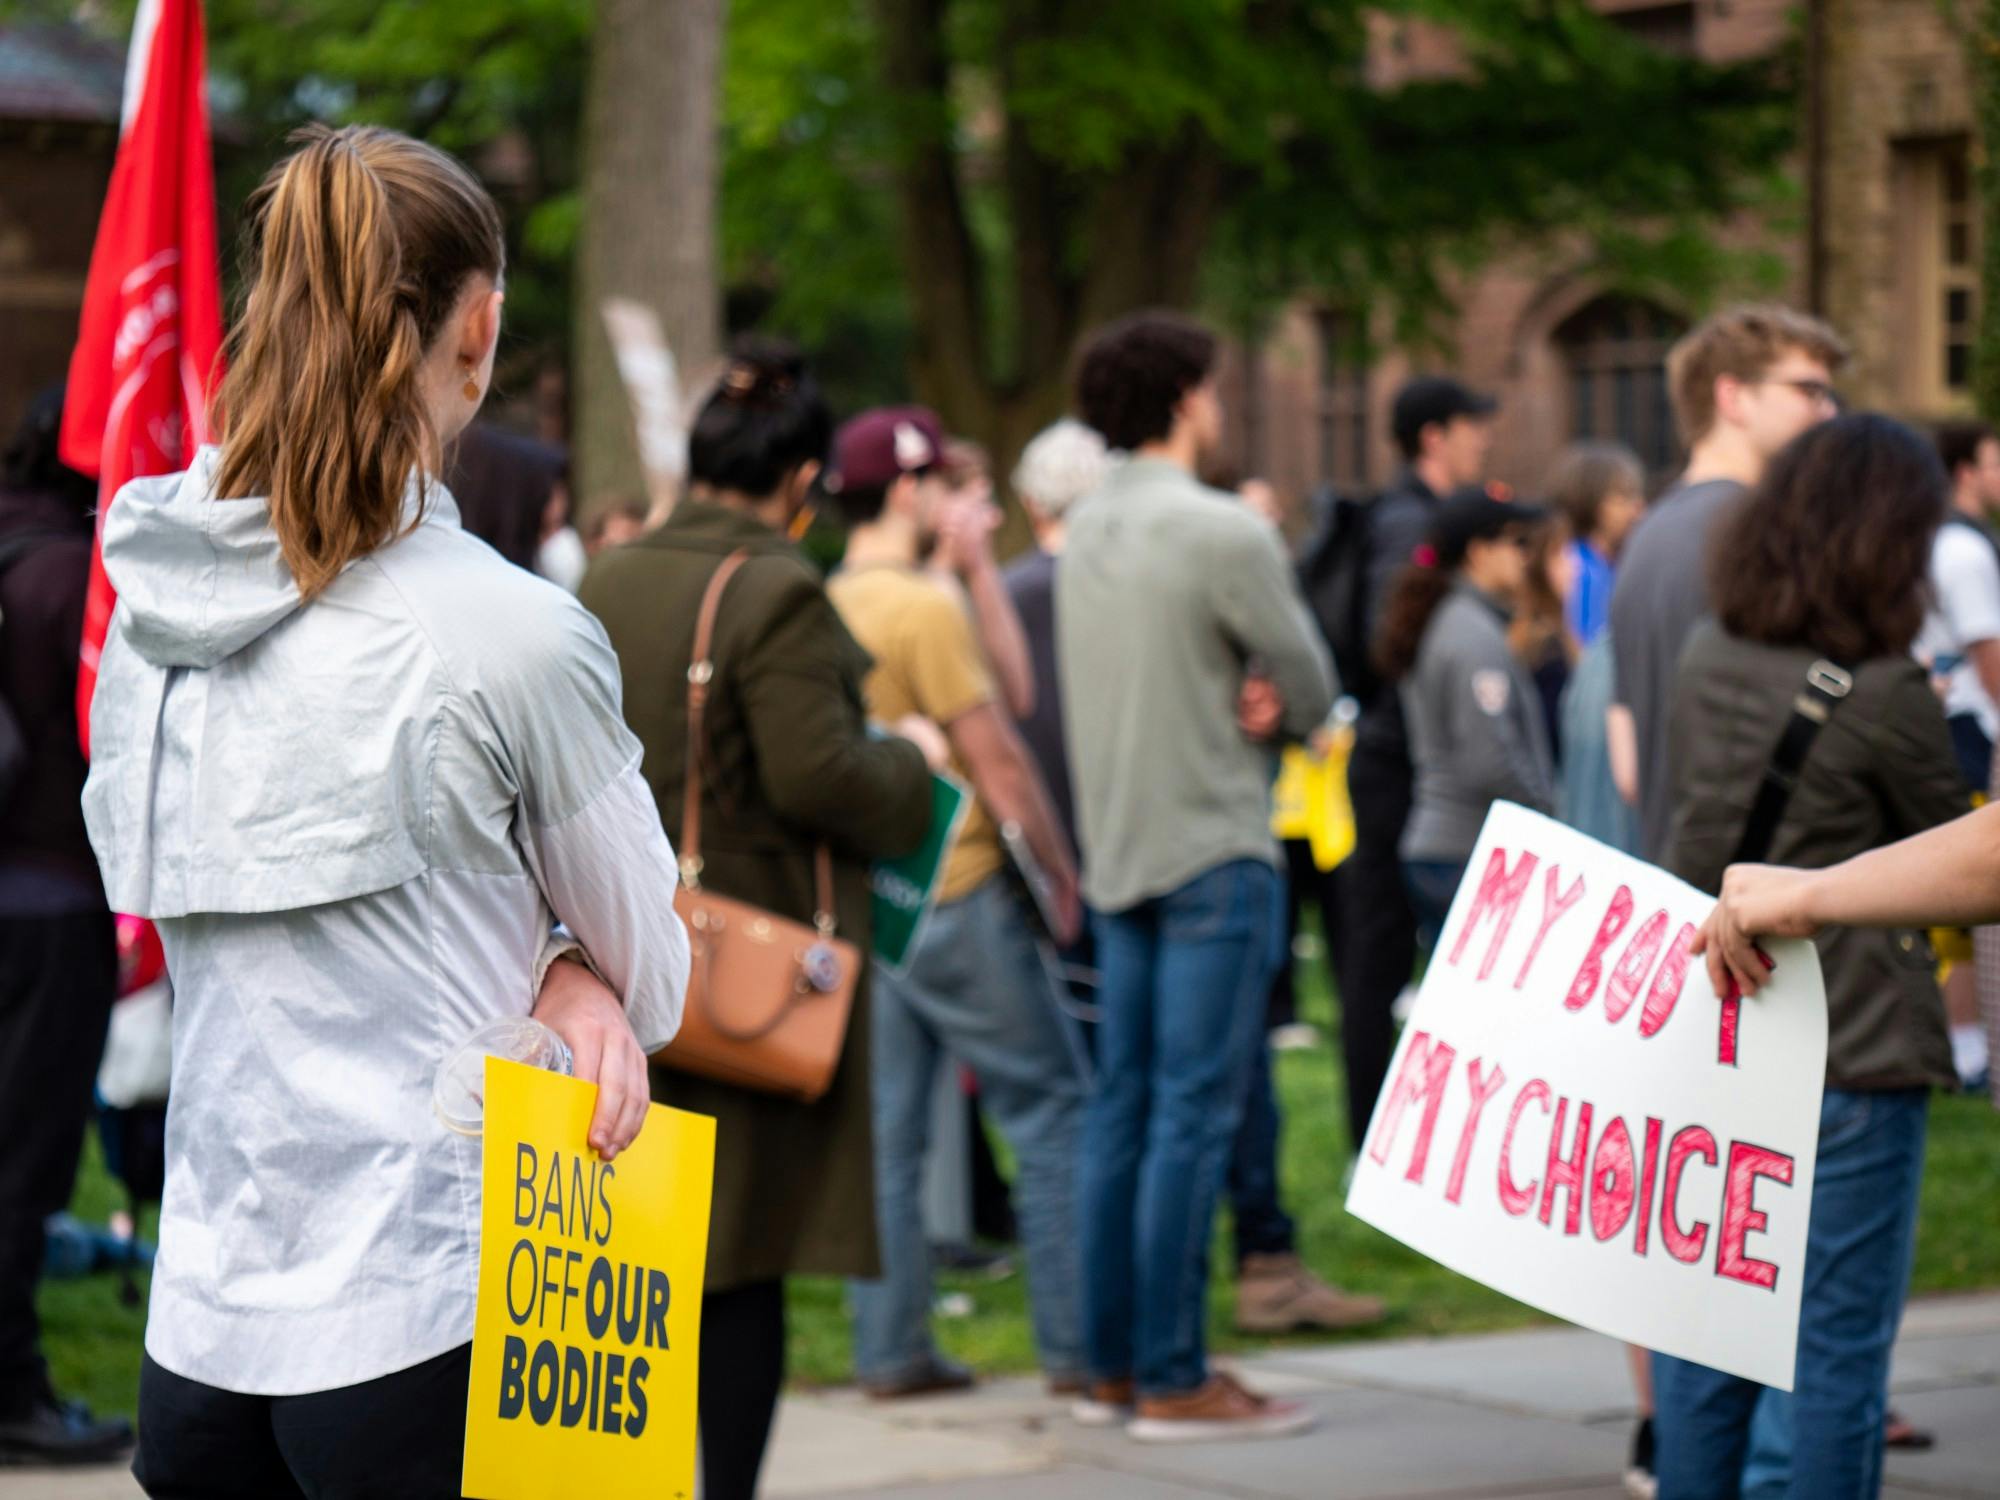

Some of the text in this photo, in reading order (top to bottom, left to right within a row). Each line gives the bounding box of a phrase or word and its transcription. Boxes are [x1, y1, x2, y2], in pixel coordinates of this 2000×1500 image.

[1447, 847, 1586, 990] MY
[514, 1142, 616, 1247] BANS
[1370, 1030, 1794, 1292] MY CHOICE
[498, 1334, 651, 1439] BODIES
